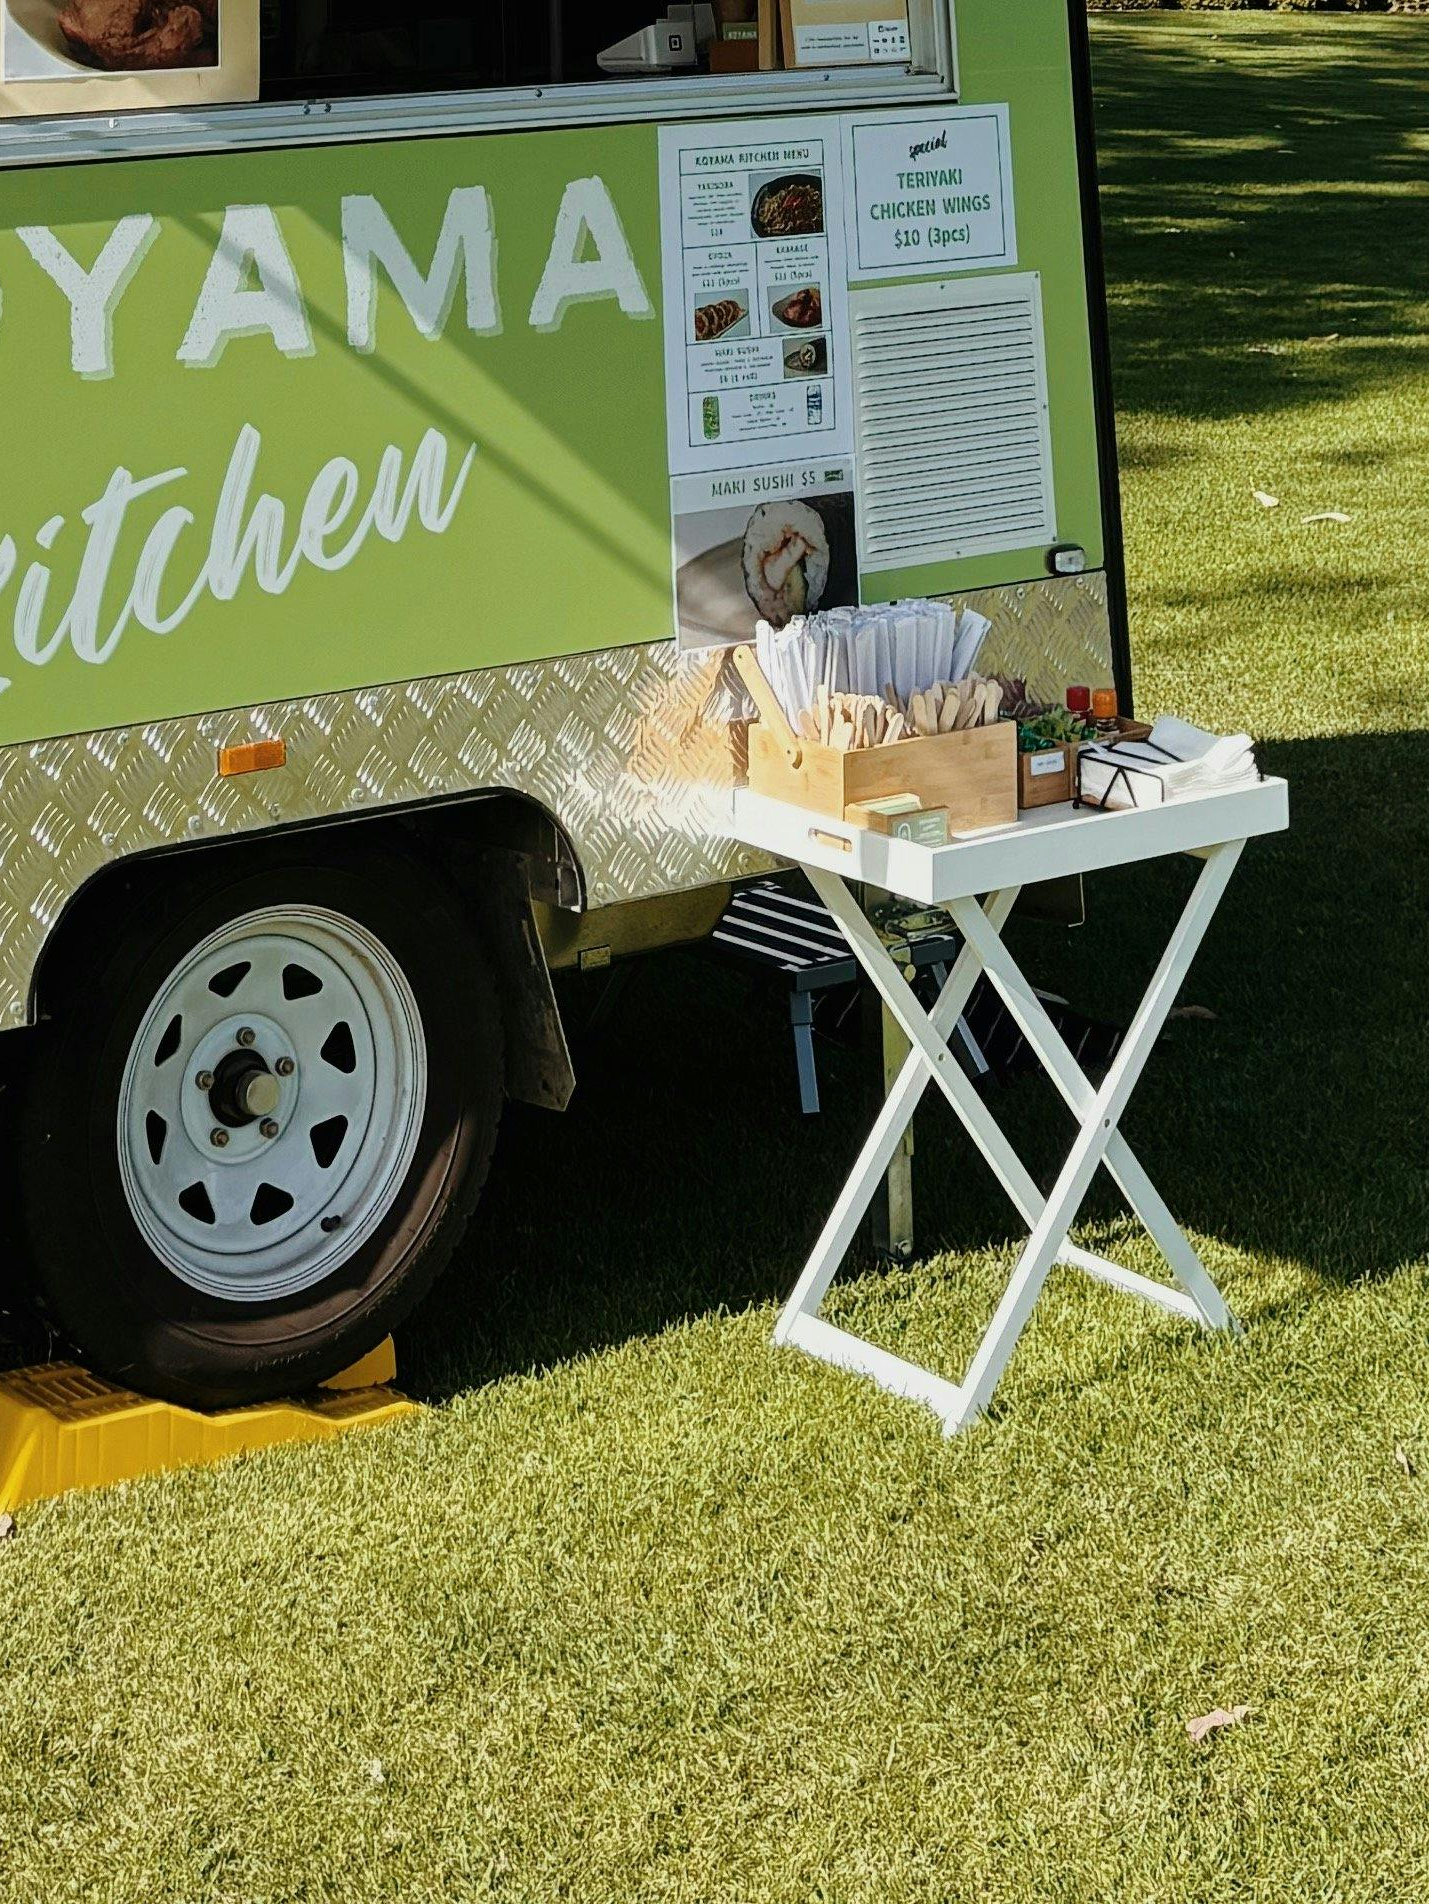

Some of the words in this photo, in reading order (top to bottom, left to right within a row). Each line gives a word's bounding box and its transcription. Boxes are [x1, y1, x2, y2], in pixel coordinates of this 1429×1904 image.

[896, 168, 963, 190] TERIYAKI
[870, 198, 936, 221] CHICKEN
[942, 193, 991, 215] WINGS
[894, 228, 920, 250] $10
[927, 223, 971, 248] (3pcs)
[711, 479, 746, 497] MAKI
[753, 473, 794, 492] SUSHI
[801, 470, 816, 487] $5
